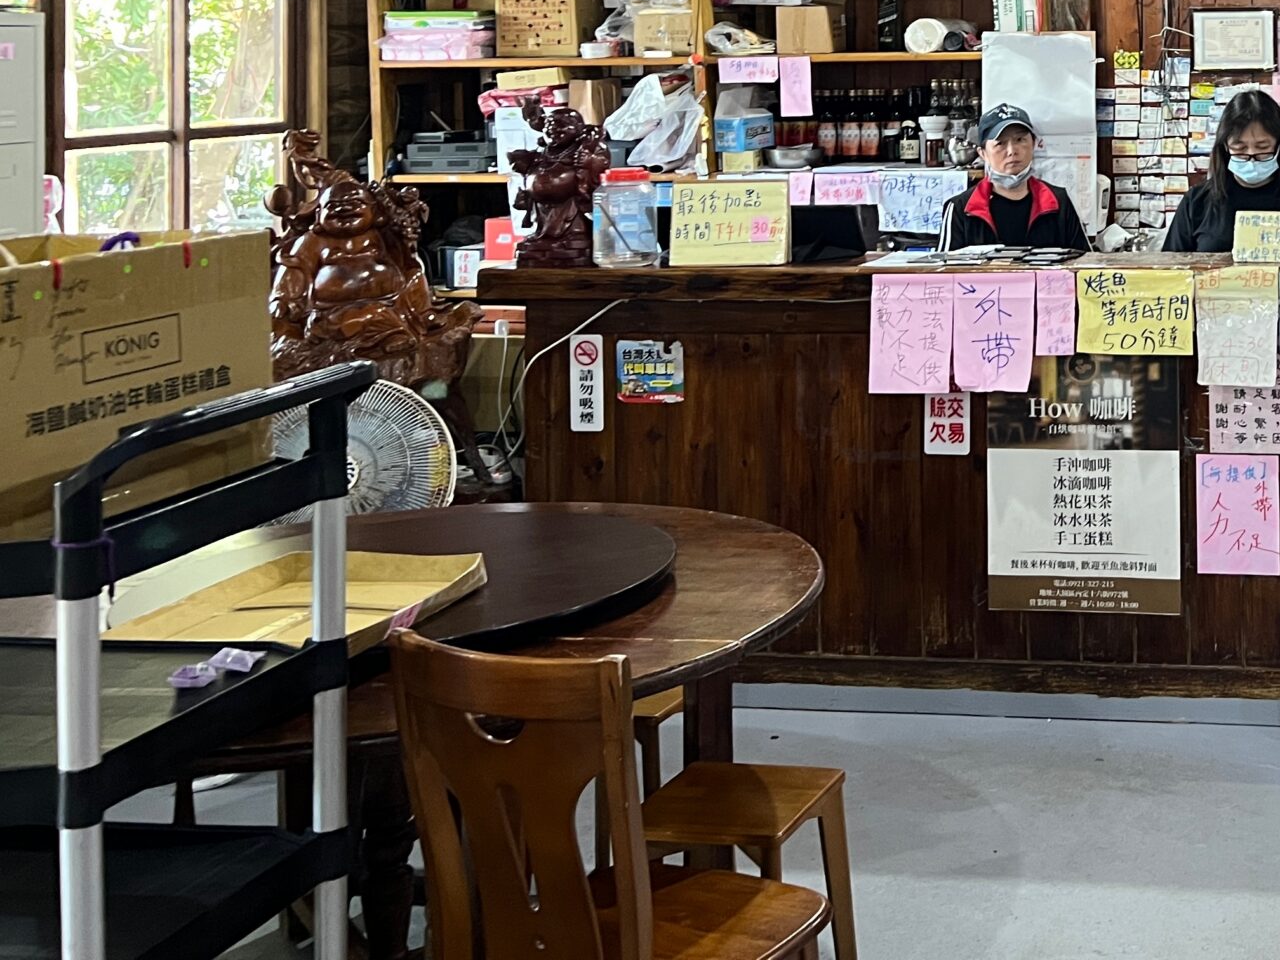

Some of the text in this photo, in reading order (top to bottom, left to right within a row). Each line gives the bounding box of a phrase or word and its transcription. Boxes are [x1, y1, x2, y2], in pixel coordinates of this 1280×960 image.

[675, 188, 763, 216] 最後加點
[1101, 294, 1190, 323] 等待時間
[104, 330, 161, 359] KÖNIG
[971, 286, 1021, 377] 外帶
[1102, 327, 1185, 352] 50分鐘
[578, 368, 595, 425] 請勿吸煙
[1028, 396, 1137, 421] How 咖啡
[929, 398, 947, 443] 賒欠
[946, 398, 965, 444] 交易
[1052, 456, 1113, 473] 手沖咖啡
[1052, 475, 1113, 491] 冰滴咖啡
[1052, 494, 1113, 510] 熱花果茶
[1052, 513, 1113, 529] 冰水果茶
[1053, 531, 1114, 547] 手工蛋糕
